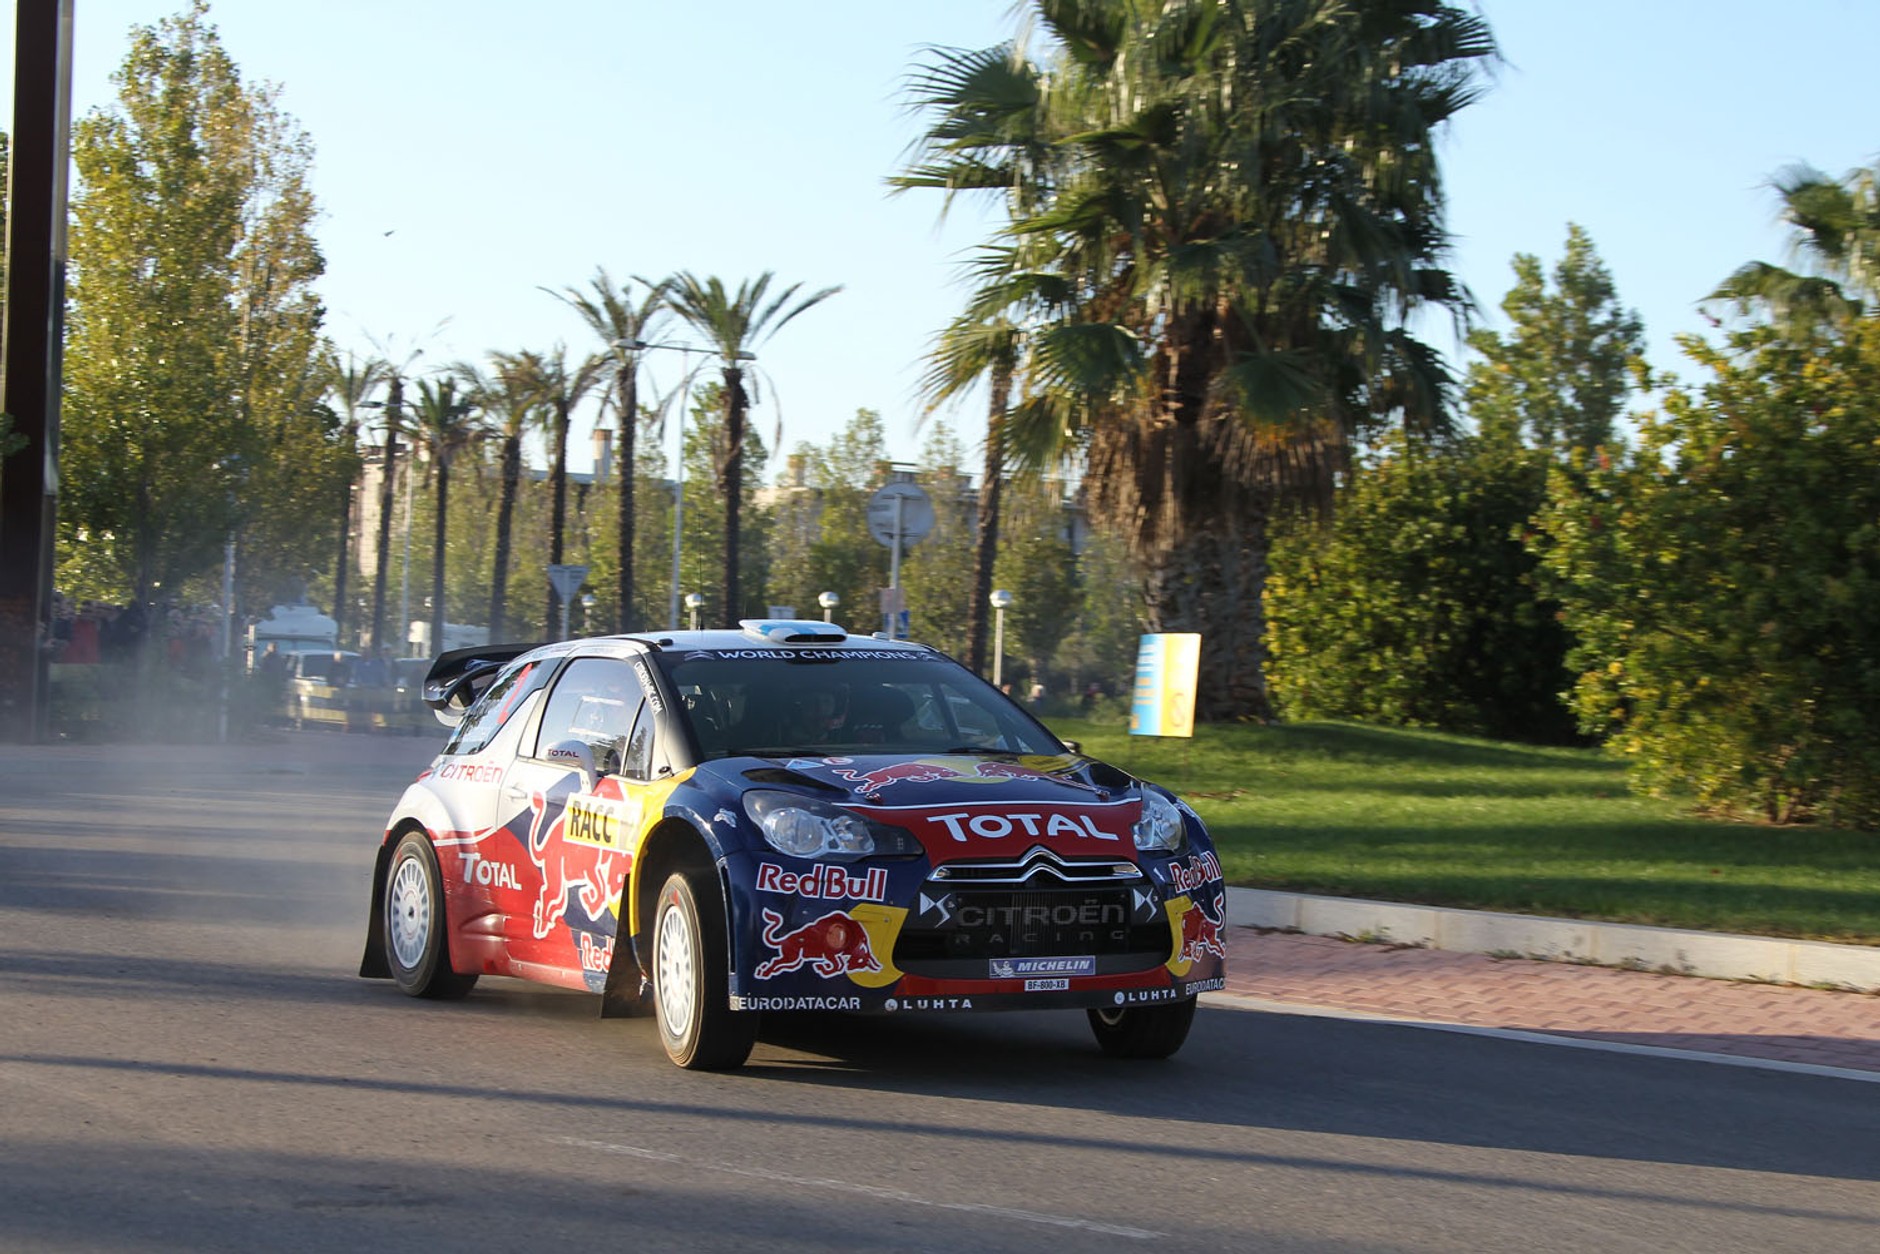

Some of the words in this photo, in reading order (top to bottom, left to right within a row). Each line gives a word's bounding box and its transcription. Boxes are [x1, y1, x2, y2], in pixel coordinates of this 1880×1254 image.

[718, 650, 797, 660] WORLD
[799, 650, 918, 661] CHAMPIONS
[547, 748, 580, 758] TOTAL
[569, 799, 615, 844] RACC
[926, 813, 1119, 842] TOTAL
[458, 852, 523, 891] TOTAL
[1016, 960, 1091, 972] MICHELIN
[1128, 988, 1177, 1002] LUHTA
[738, 997, 861, 1010] EURODATACAR
[903, 999, 973, 1010] LUHTA
